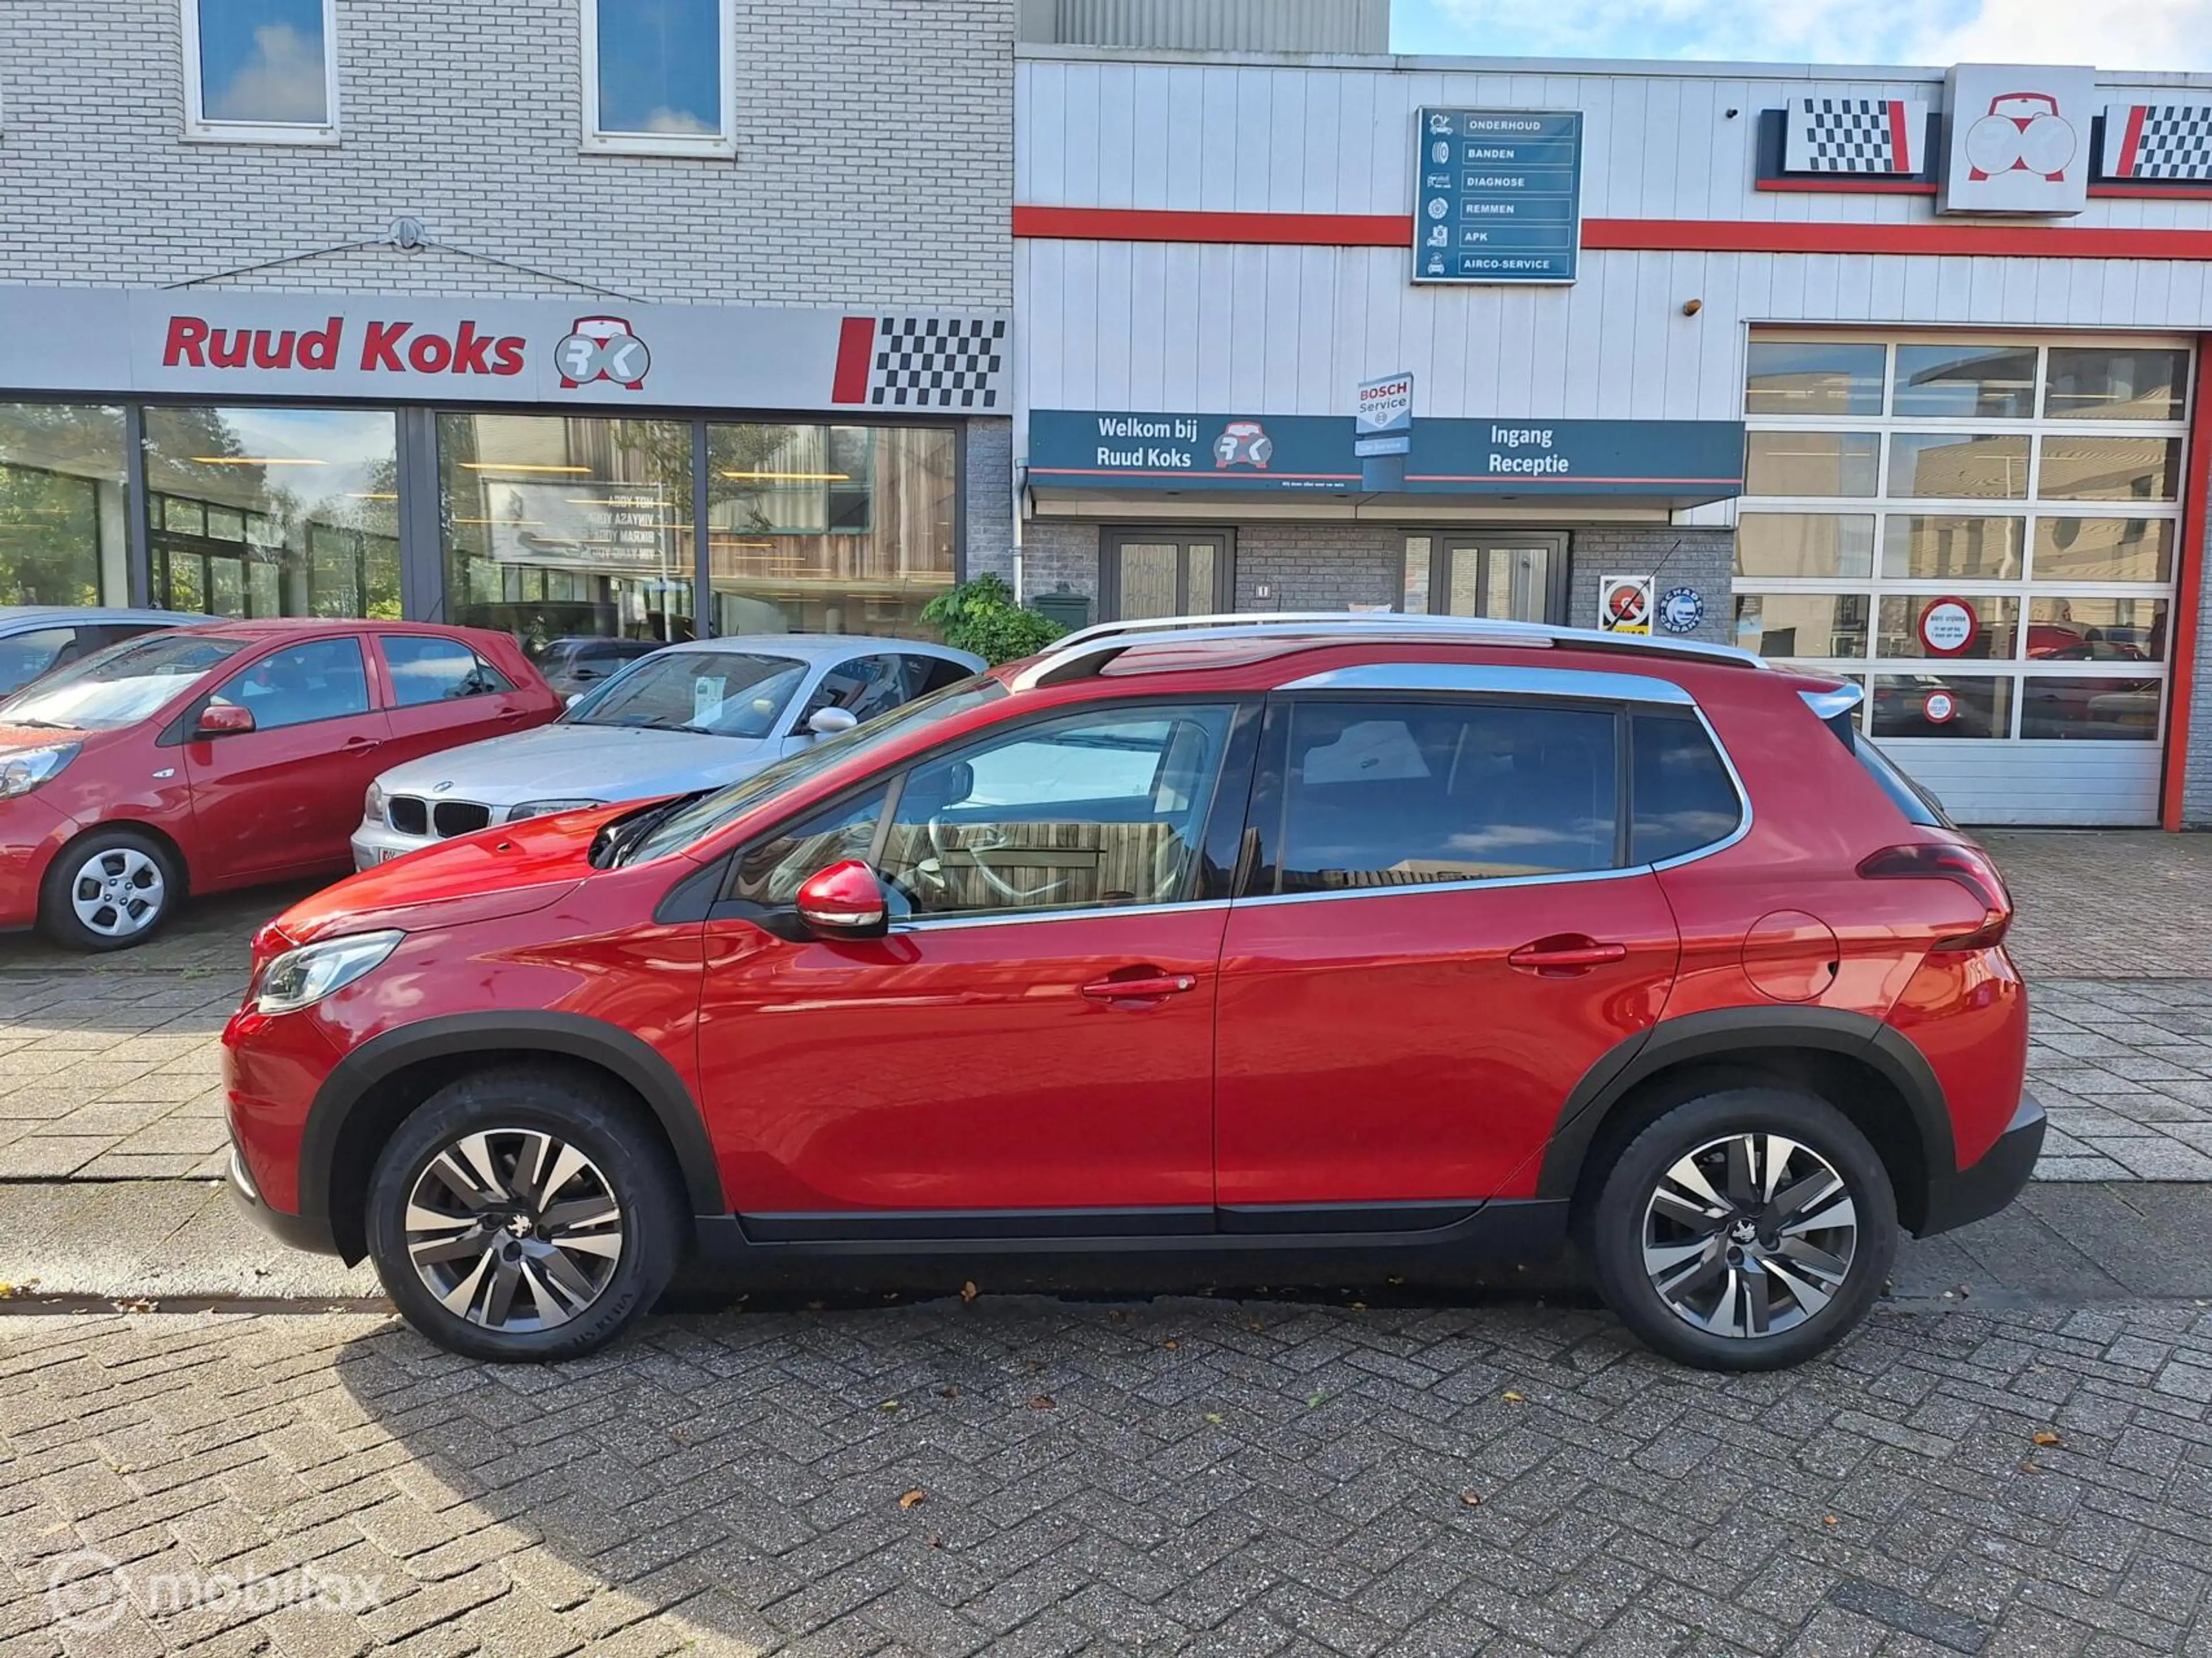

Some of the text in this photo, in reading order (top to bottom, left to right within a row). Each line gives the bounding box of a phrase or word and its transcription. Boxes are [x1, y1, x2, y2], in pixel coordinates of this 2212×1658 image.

[1469, 121, 1541, 131] ONDERHOUD
[1468, 149, 1514, 158] BANDEN
[1467, 177, 1525, 187] DIAGNOSE
[1466, 204, 1514, 214] REMMEN
[1464, 233, 1488, 241] APK
[1464, 260, 1550, 269] AIRCO-SERVICE
[162, 316, 527, 376] Ruud Koks
[1360, 382, 1407, 401] BOSCH
[1359, 398, 1407, 413] Service
[1098, 418, 1198, 442] Welkom bij
[1491, 426, 1553, 447] Ingang
[1096, 447, 1191, 468] Ruud Koks
[1488, 454, 1569, 476] Receptie
